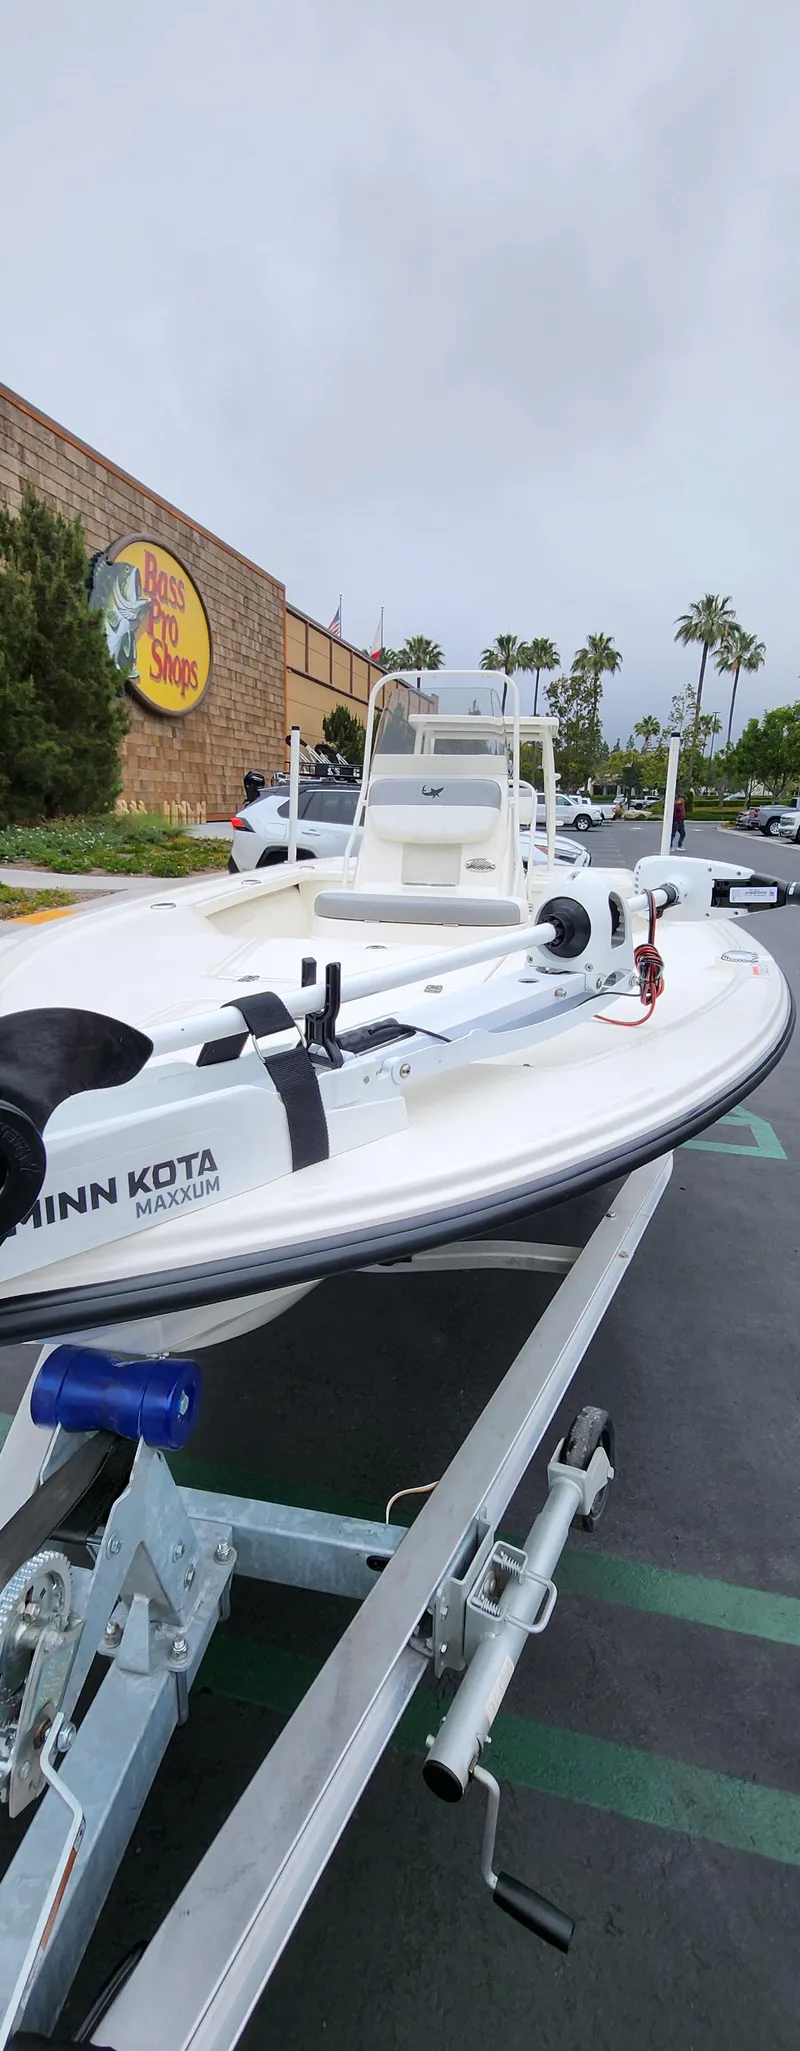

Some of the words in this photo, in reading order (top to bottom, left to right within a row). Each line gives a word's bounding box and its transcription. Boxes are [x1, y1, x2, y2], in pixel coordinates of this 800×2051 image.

[144, 550, 185, 612] Bass
[148, 600, 178, 646] Pro
[150, 639, 198, 698] Shops
[127, 1148, 218, 1198] KOTA
[135, 1175, 220, 1218] MAXXUM
